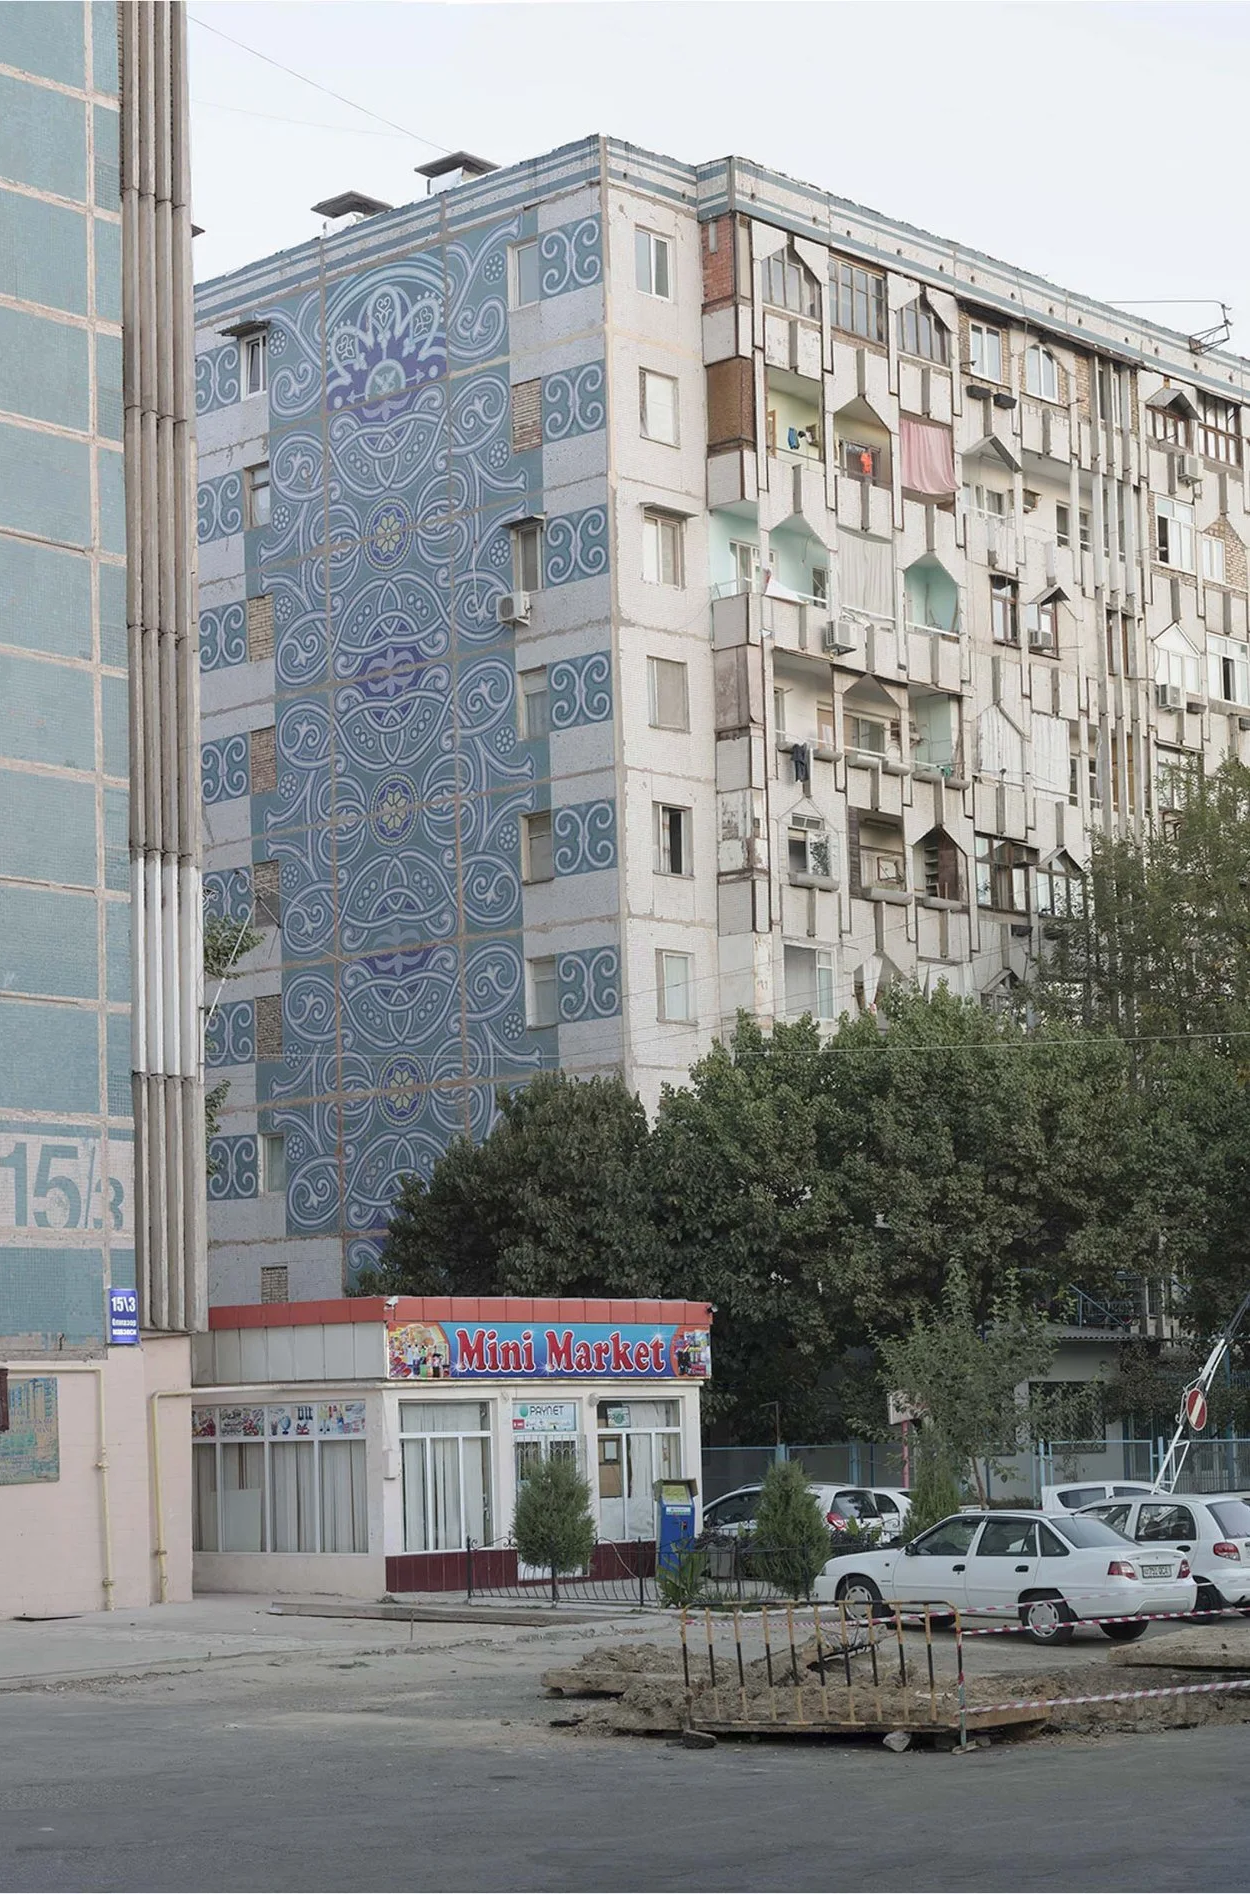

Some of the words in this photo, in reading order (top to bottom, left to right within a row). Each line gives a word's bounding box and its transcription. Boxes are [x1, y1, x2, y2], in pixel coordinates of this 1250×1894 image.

[0, 1142, 125, 1230] 15/3
[111, 1296, 136, 1312] 15\3
[456, 1329, 534, 1371] Mini
[546, 1330, 665, 1371] Market
